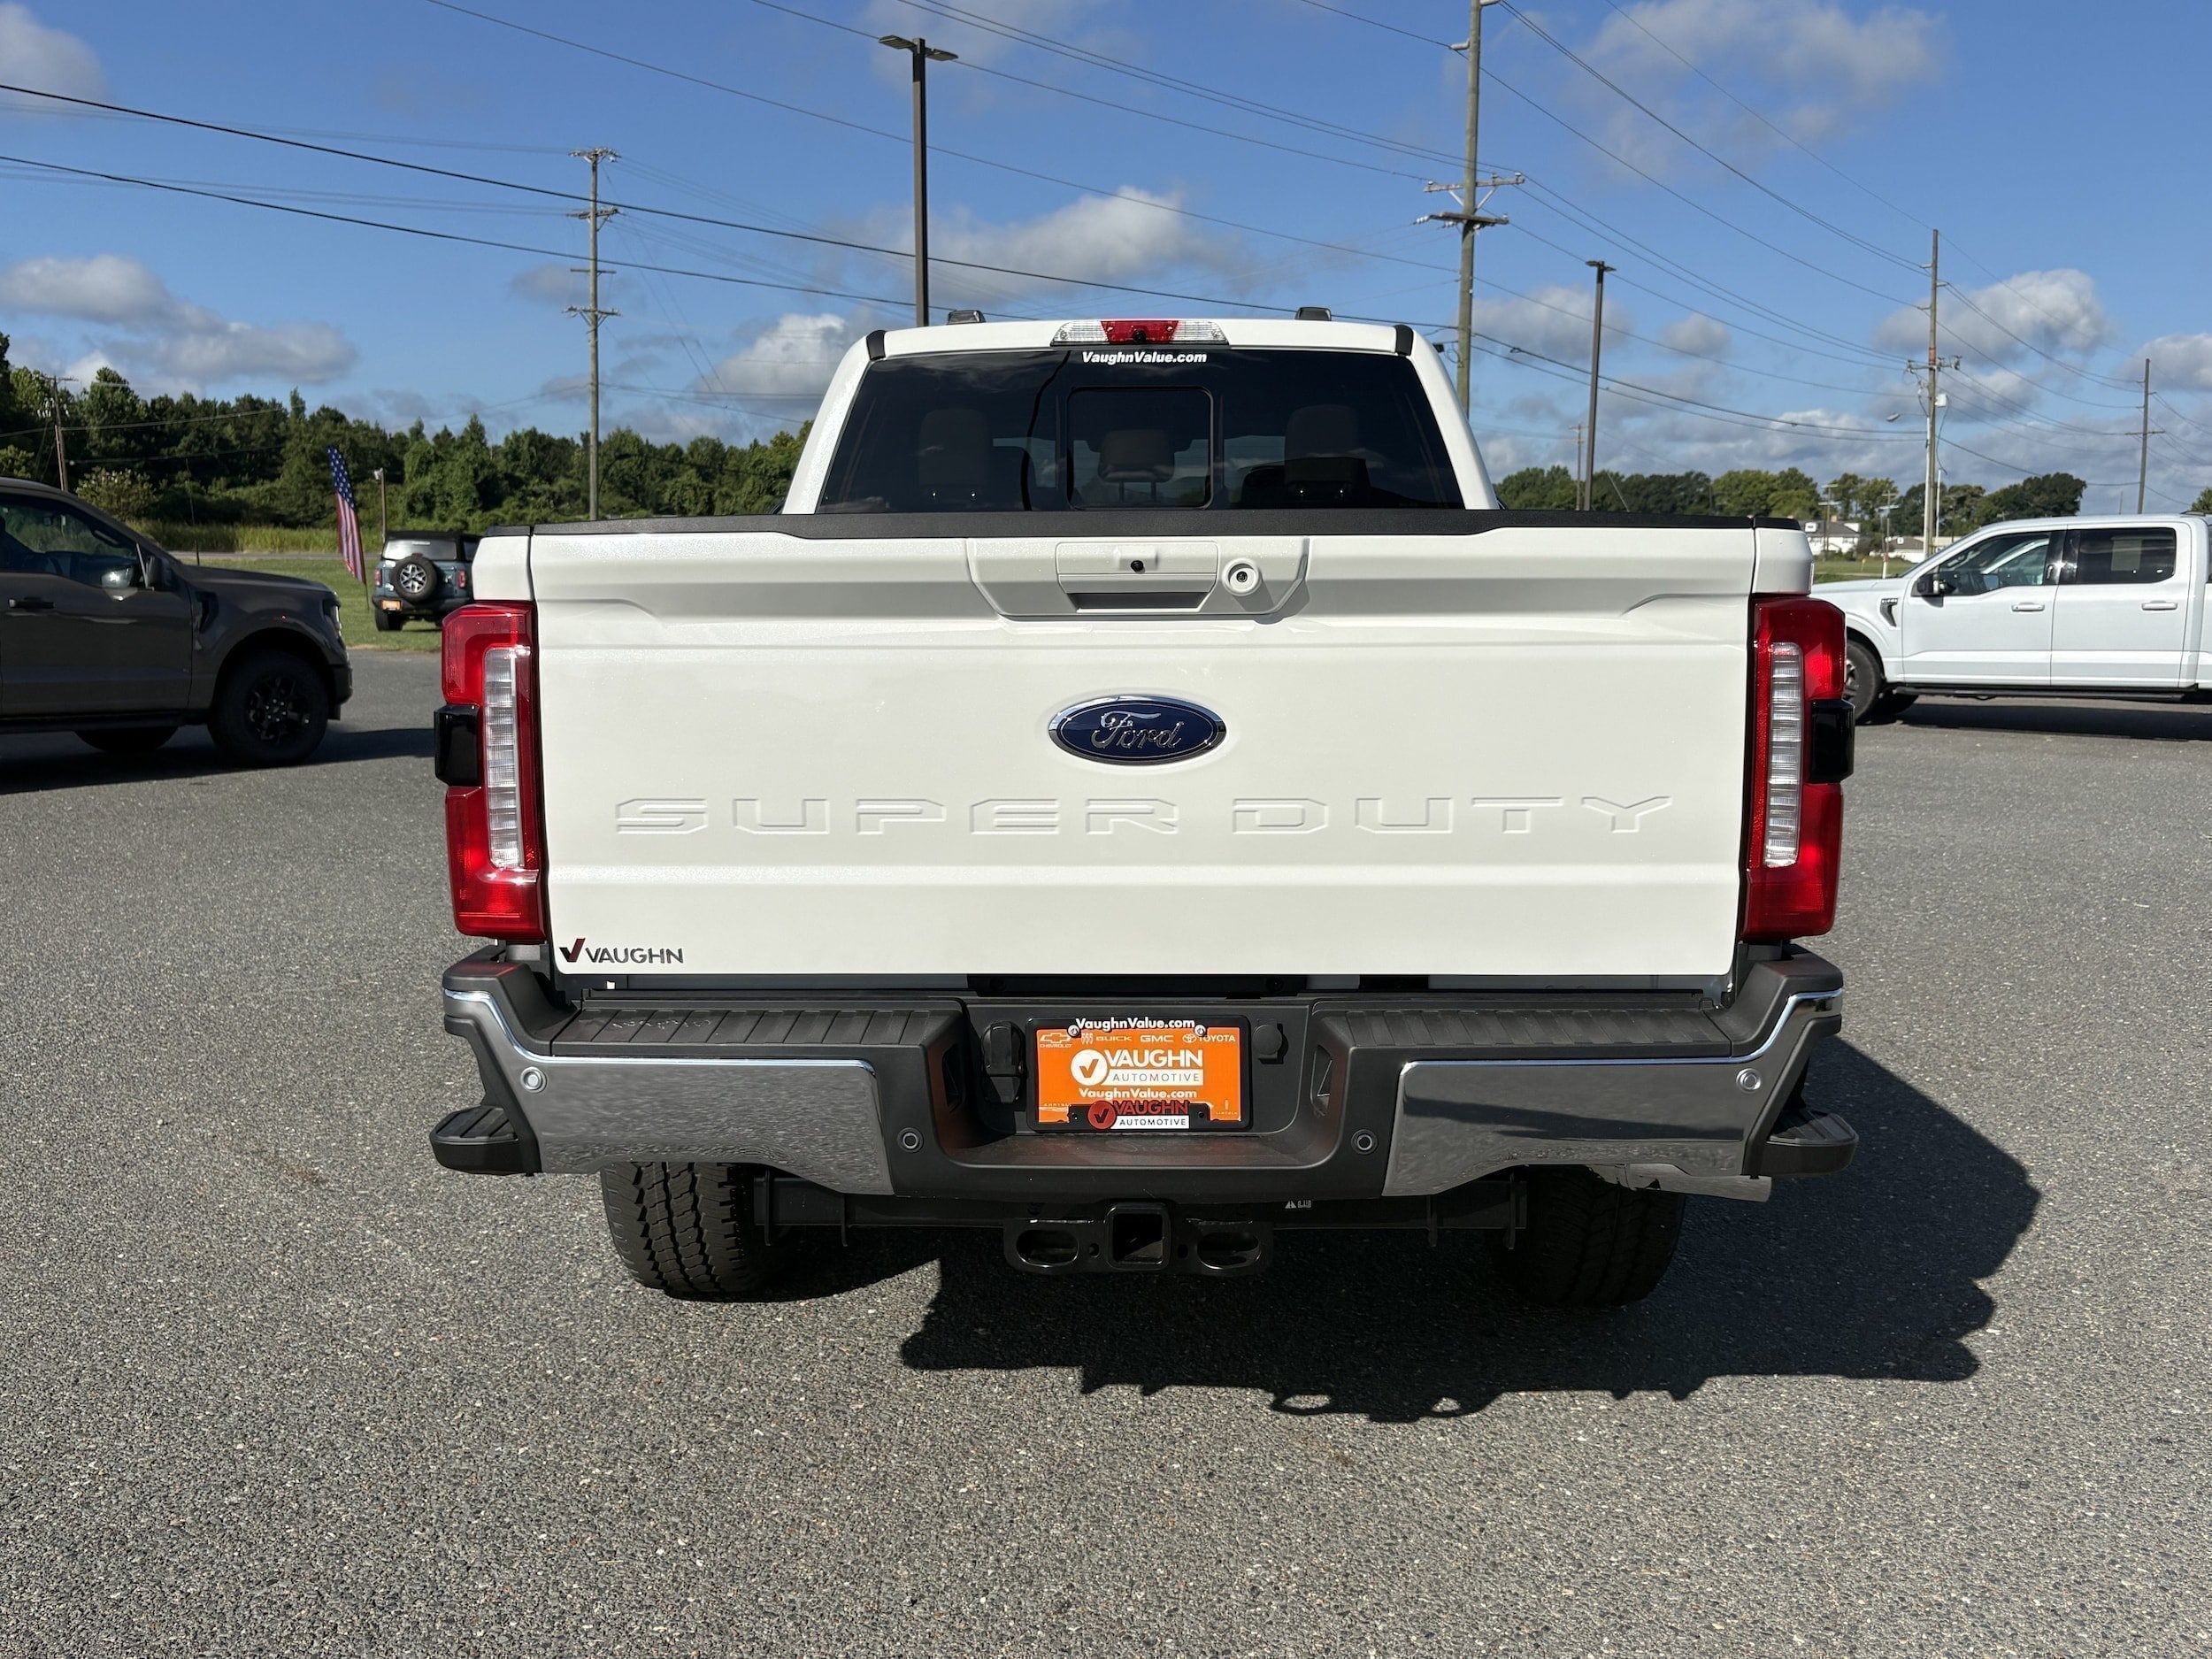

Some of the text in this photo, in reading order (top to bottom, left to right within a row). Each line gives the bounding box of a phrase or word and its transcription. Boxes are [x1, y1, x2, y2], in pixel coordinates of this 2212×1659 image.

[1082, 351, 1207, 365] VaughnValue.com
[1091, 710, 1184, 749] Ford
[616, 796, 1673, 834] SUPER DUTY
[585, 948, 684, 964] VAUGHN
[1076, 1017, 1195, 1032] VaughnValue.com
[1104, 1049, 1203, 1067] VAUGHN
[1112, 1073, 1200, 1082] AUTOMOTIVE
[1079, 1087, 1197, 1101] VaughnValue.com
[1113, 1100, 1189, 1115] VAUGHN
